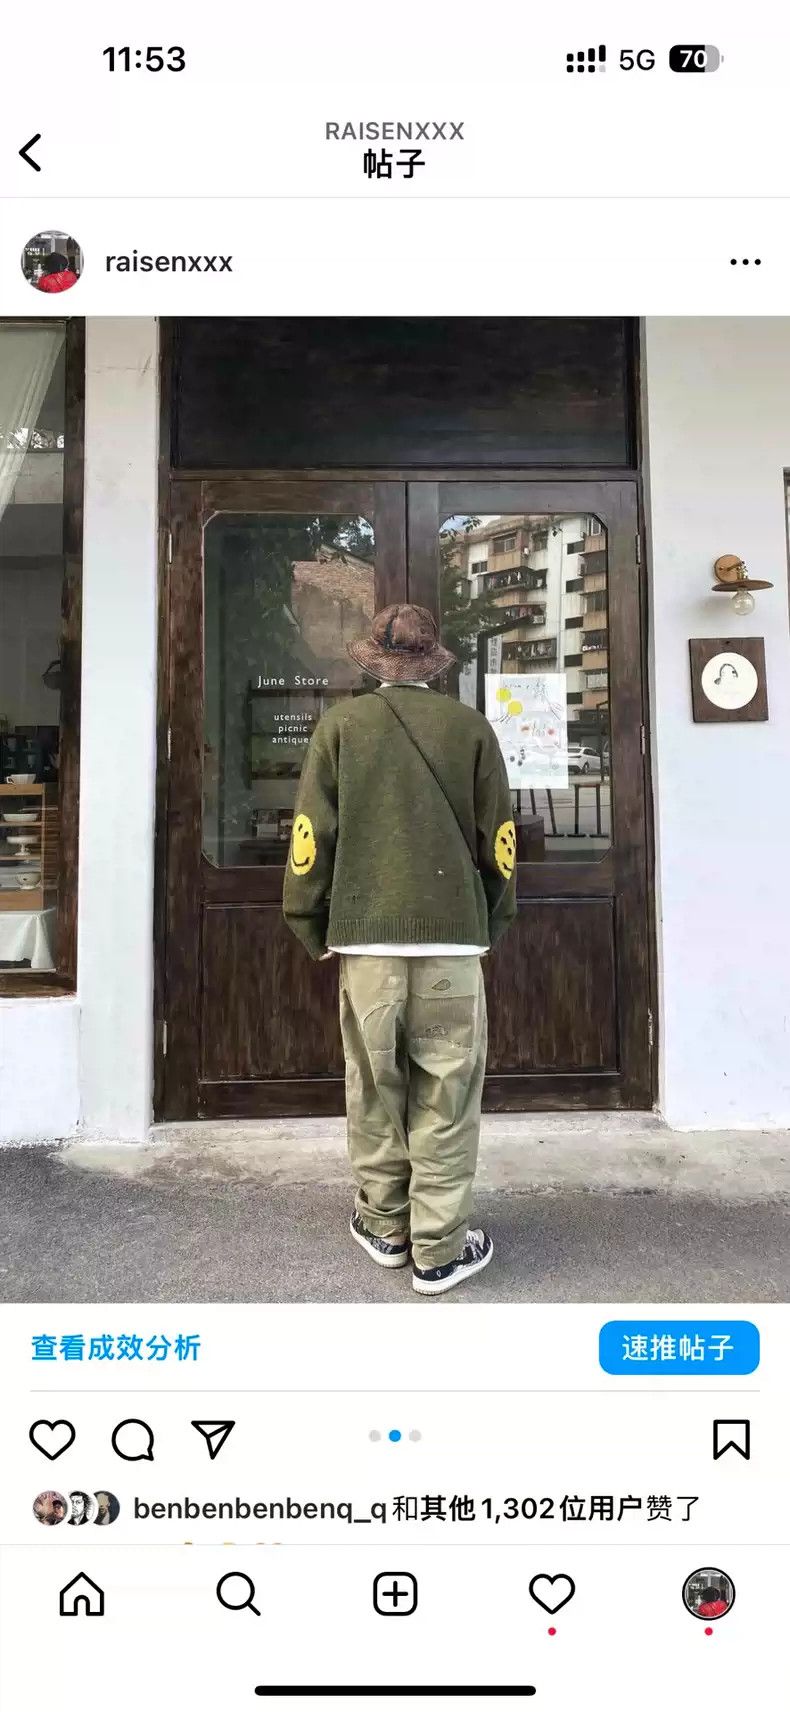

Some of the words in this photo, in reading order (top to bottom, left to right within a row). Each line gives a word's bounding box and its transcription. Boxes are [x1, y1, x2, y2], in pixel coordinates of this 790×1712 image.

[103, 46, 186, 73] 11:53
[620, 49, 656, 71] 5G
[680, 50, 708, 68] 70
[325, 121, 465, 141] RAISENXXX
[363, 148, 426, 179] 帖子
[105, 250, 233, 273] raisenxxx
[257, 675, 285, 688] June
[294, 675, 329, 686] Store
[274, 712, 313, 721] utensils
[278, 724, 308, 734] picnic
[31, 1334, 202, 1362] 查看成效分析
[621, 1334, 734, 1362] 速推帖子
